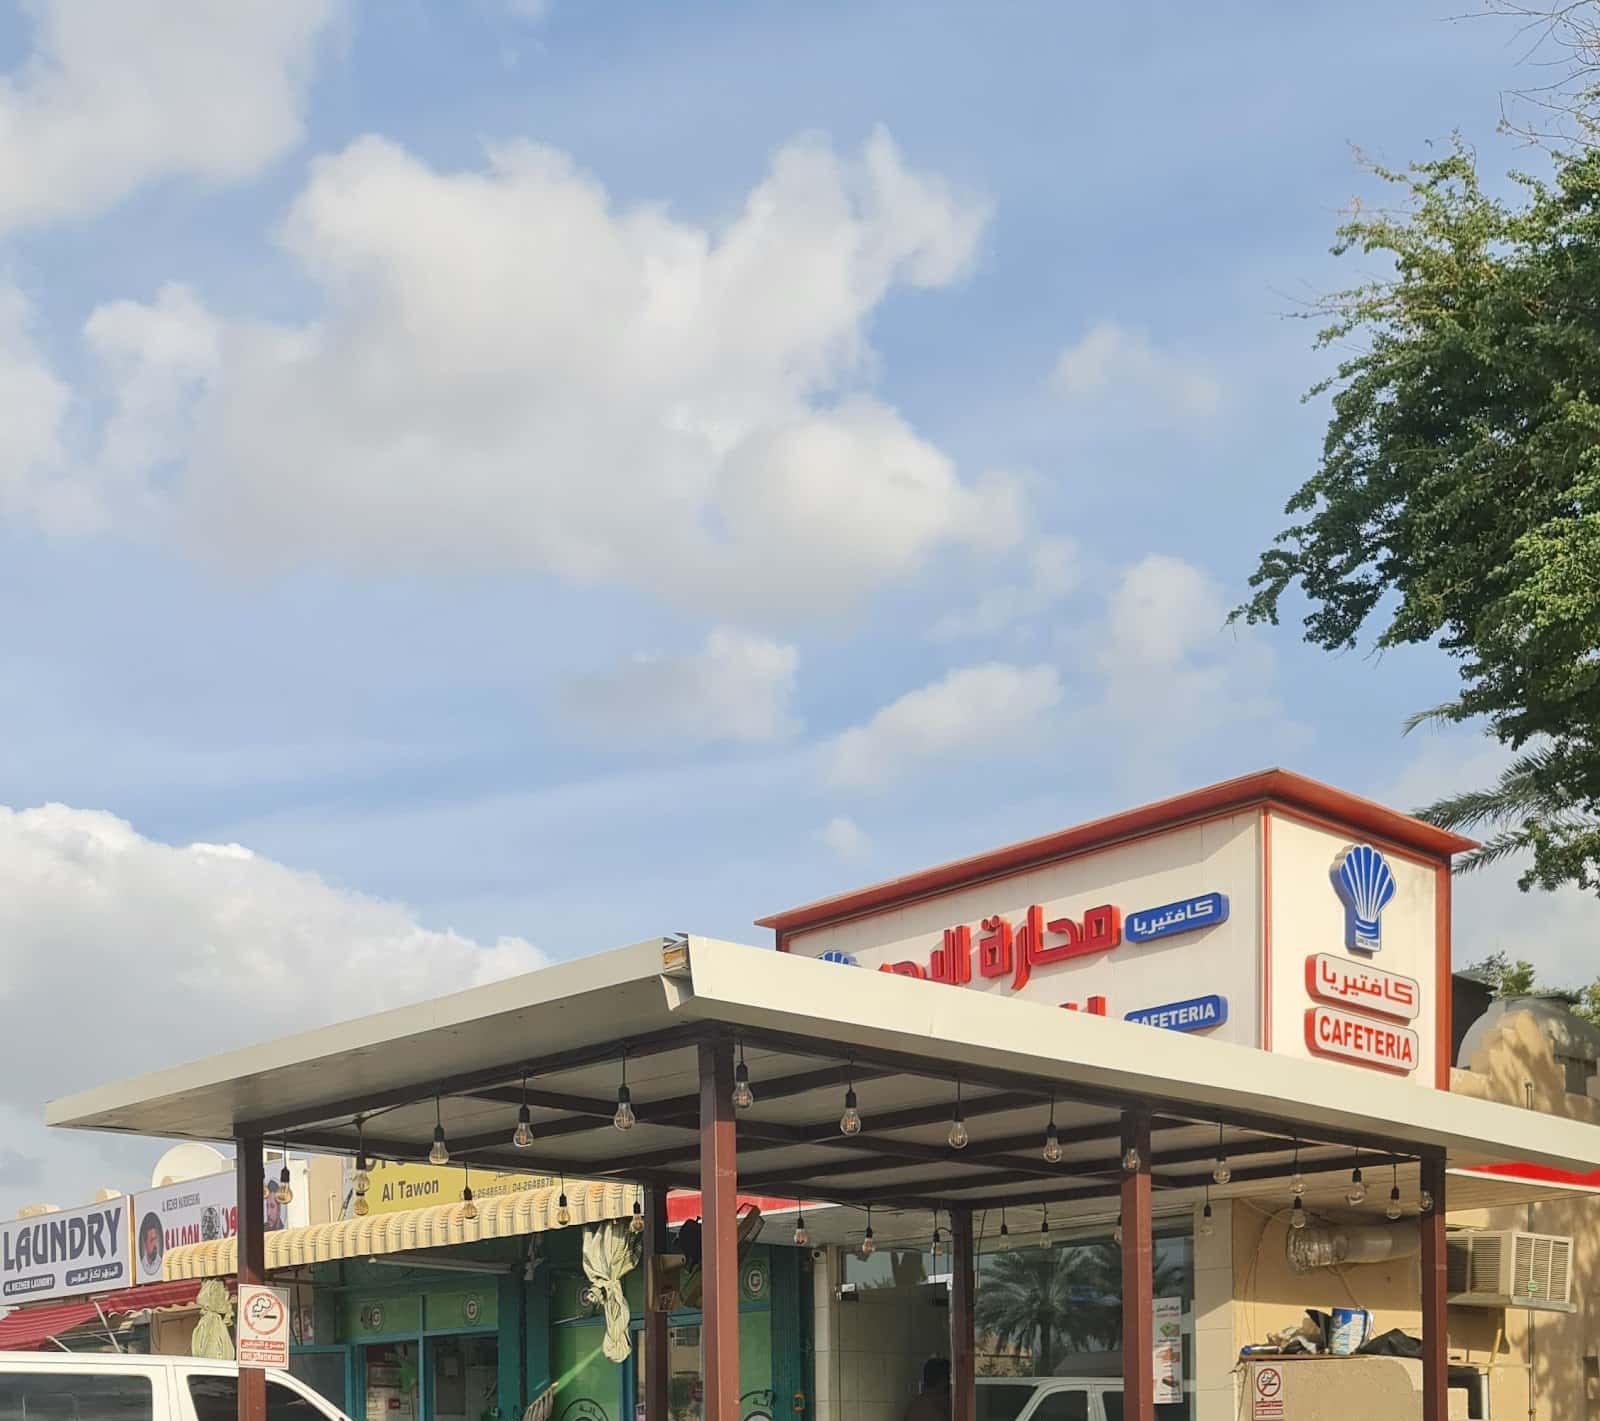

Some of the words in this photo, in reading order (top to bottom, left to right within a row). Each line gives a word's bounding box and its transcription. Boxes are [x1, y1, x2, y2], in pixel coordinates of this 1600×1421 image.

[1133, 899, 1214, 936] كافتيريا
[979, 903, 1121, 991] محارة
[1322, 960, 1413, 1006] كافتيريا
[1319, 1015, 1413, 1063] CAFETERIA
[382, 1182, 394, 1202] Al
[398, 1178, 439, 1199] Tawon
[3, 1207, 121, 1272] LAUNDRY
